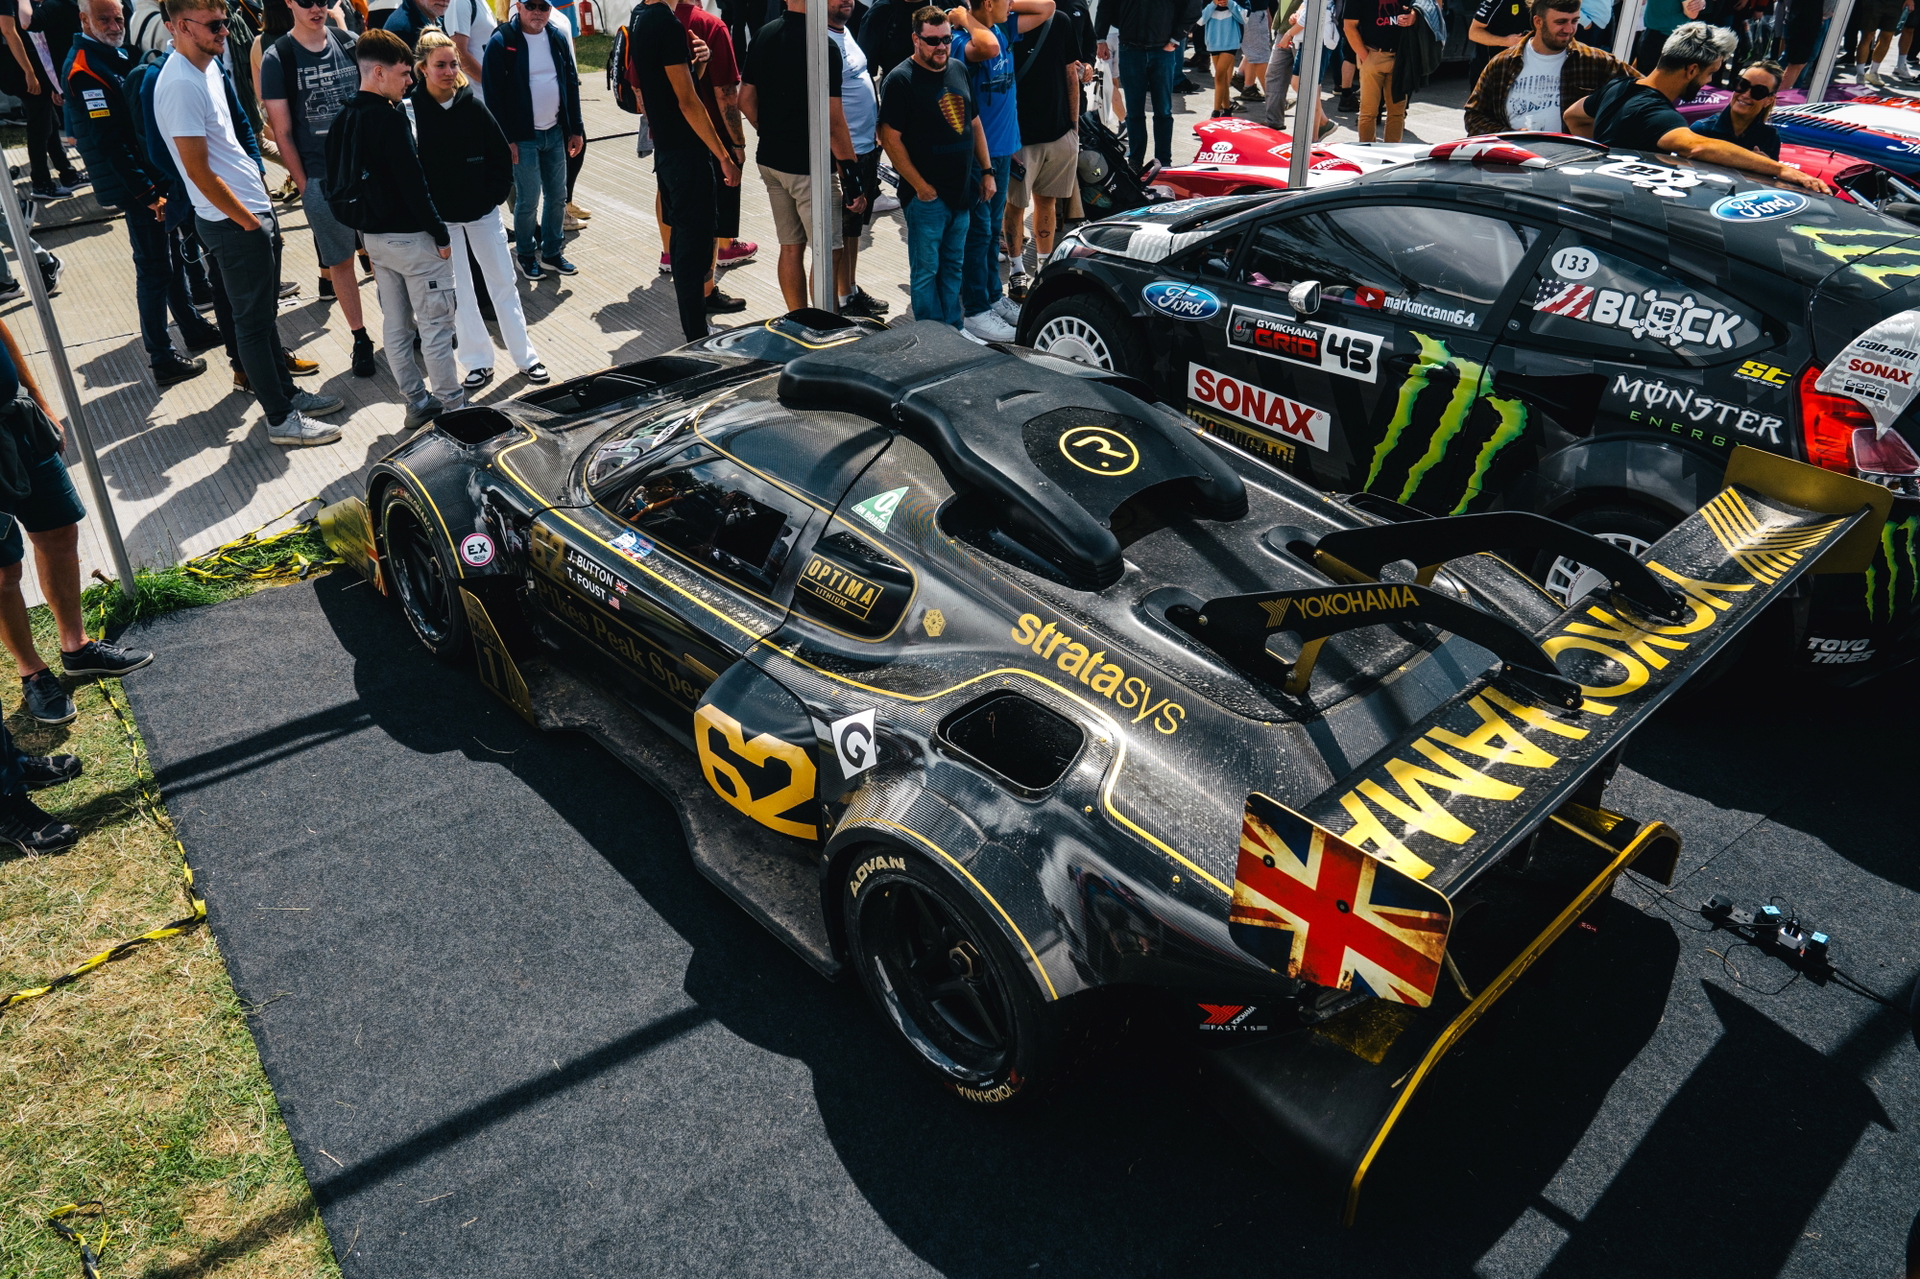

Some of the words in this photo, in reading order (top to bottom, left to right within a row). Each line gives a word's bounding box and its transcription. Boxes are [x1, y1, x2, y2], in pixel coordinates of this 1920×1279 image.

[1376, 16, 1398, 26] CAN
[1197, 152, 1240, 163] BOMEX
[1728, 195, 1795, 218] Ford
[1559, 253, 1590, 273] 133
[1157, 286, 1208, 316] Ford
[1383, 295, 1476, 328] markmccann64
[1652, 306, 1677, 323] 43
[1256, 319, 1319, 341] GYMKHANA
[1326, 332, 1375, 375] 43
[1856, 340, 1919, 361] can-am
[1848, 358, 1914, 386] SONAX
[1845, 379, 1889, 396] GoPro
[1194, 369, 1317, 443] SONAX
[1629, 410, 1747, 447] ENERG
[855, 504, 867, 517] ON
[864, 509, 887, 530] BOARD
[467, 542, 488, 555] EX
[567, 550, 576, 564] J.
[576, 555, 614, 588] BUTTON
[808, 559, 875, 606] OPTIMA
[566, 566, 576, 582] T.
[577, 573, 606, 601] FOUST
[815, 587, 848, 608] LITHIUM
[1293, 585, 1421, 620] YOKOHAMA
[590, 612, 647, 670] Peak
[650, 650, 703, 702] Spec
[1807, 636, 1871, 653] TOYO
[1811, 649, 1877, 664] TIRES
[1011, 612, 1187, 735] stratasys
[840, 721, 873, 769] G
[694, 703, 819, 842] 62
[849, 855, 907, 899] ADVAN
[1210, 1024, 1238, 1032] FAST
[955, 1081, 1016, 1103] YOKOHAMA
